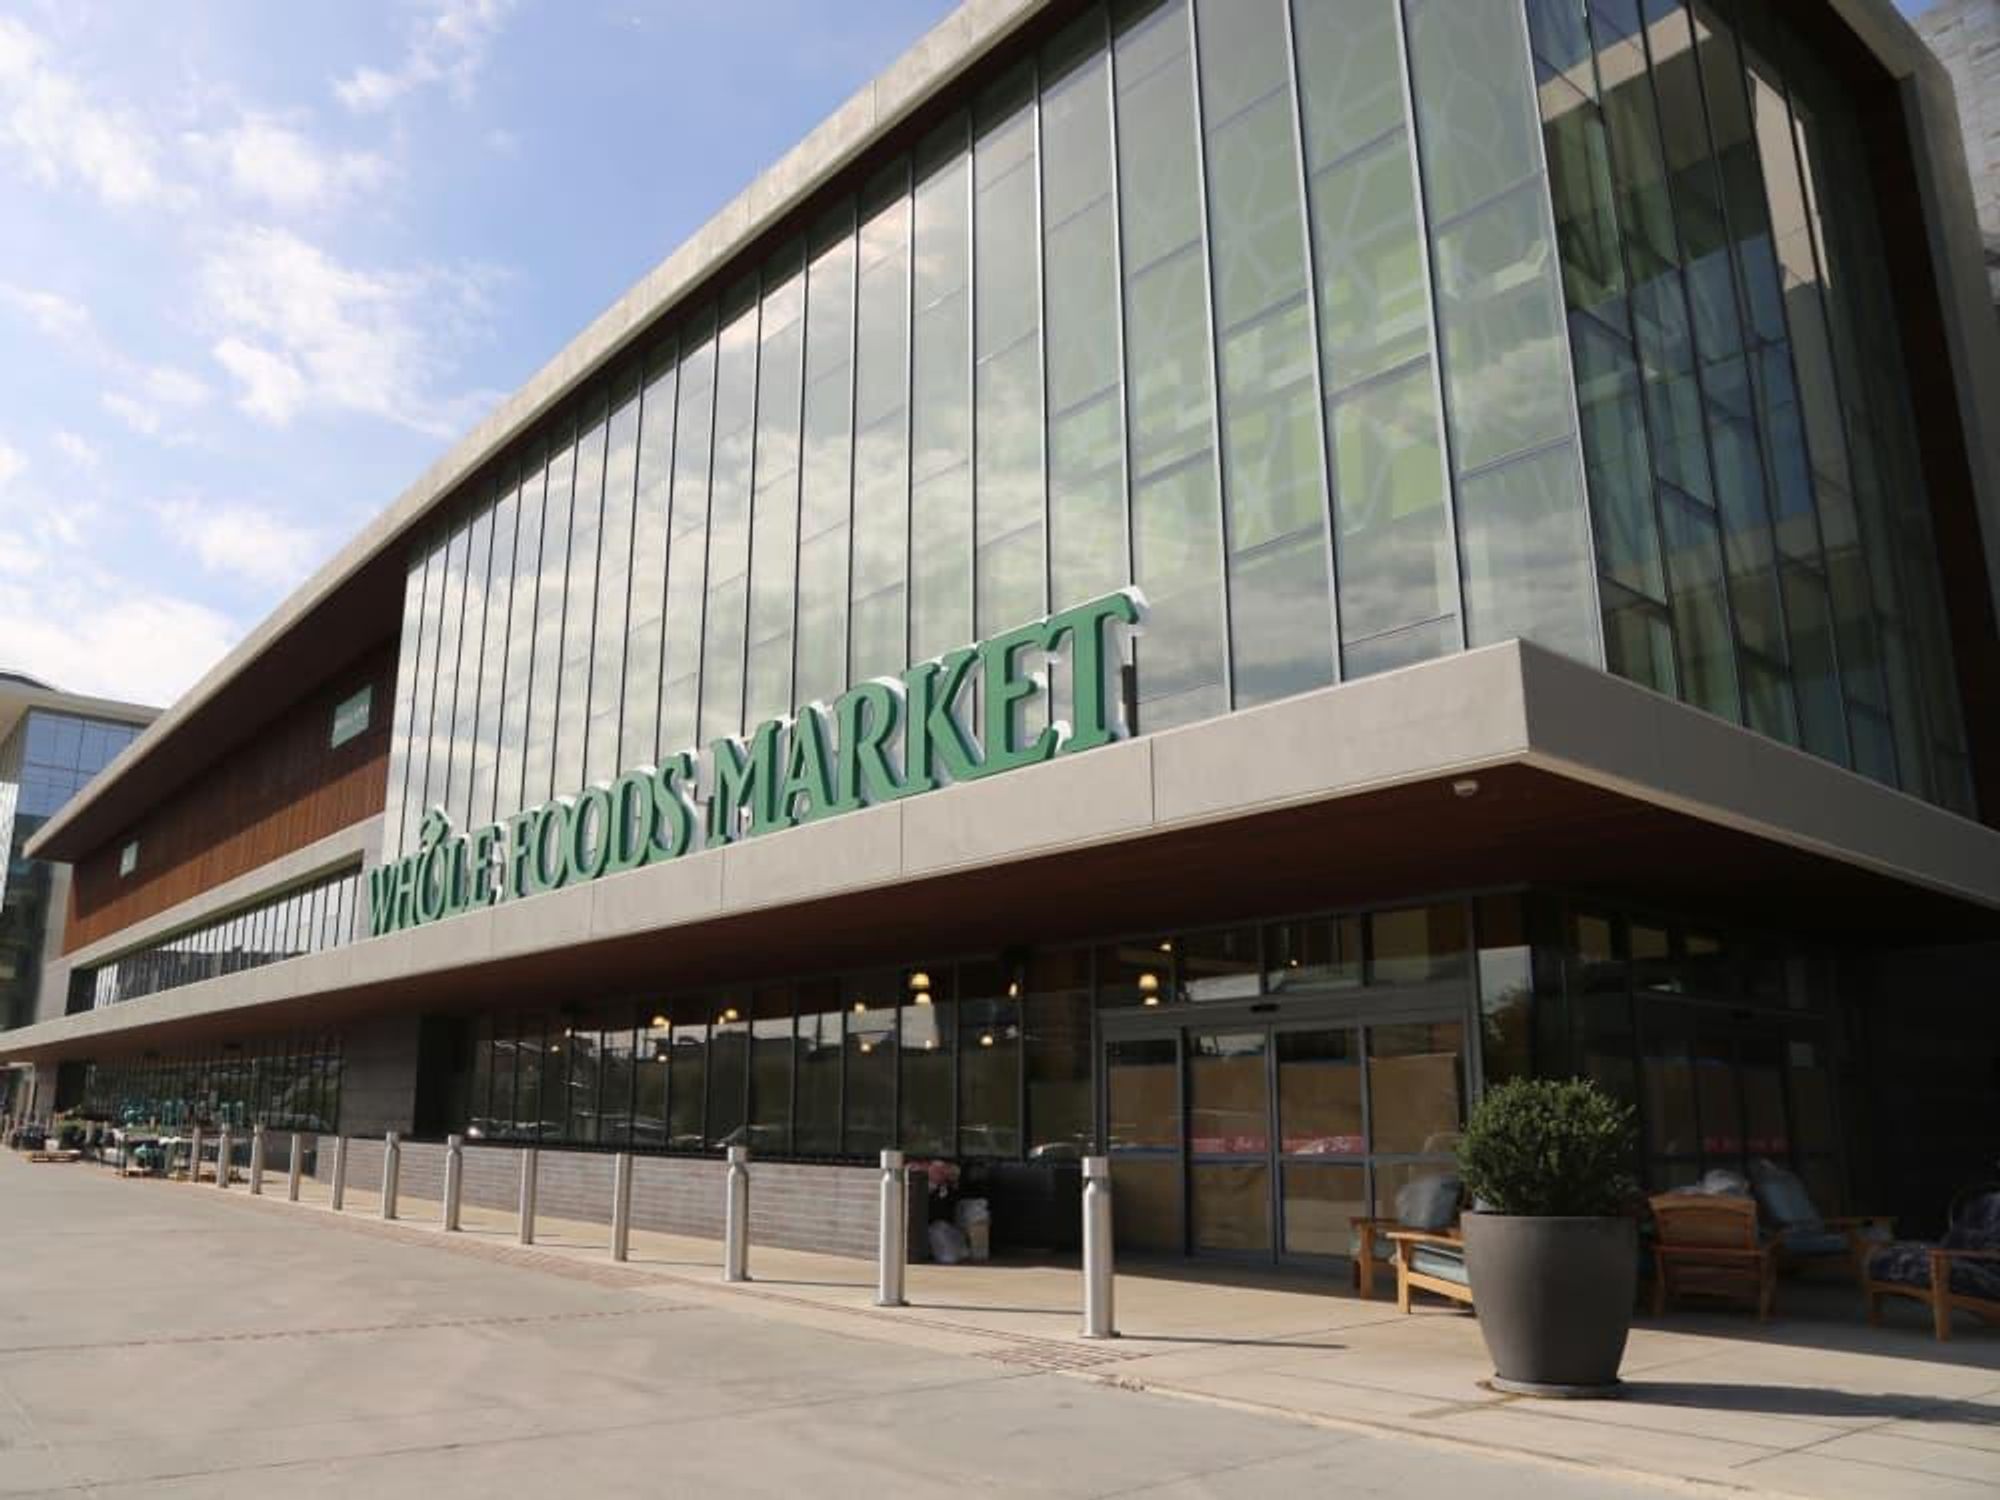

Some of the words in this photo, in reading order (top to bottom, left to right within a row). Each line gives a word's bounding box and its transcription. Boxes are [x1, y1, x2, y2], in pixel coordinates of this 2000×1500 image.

[367, 807, 502, 936] WHOLE
[507, 752, 692, 900] FOODS
[706, 590, 1140, 847] MARKET
